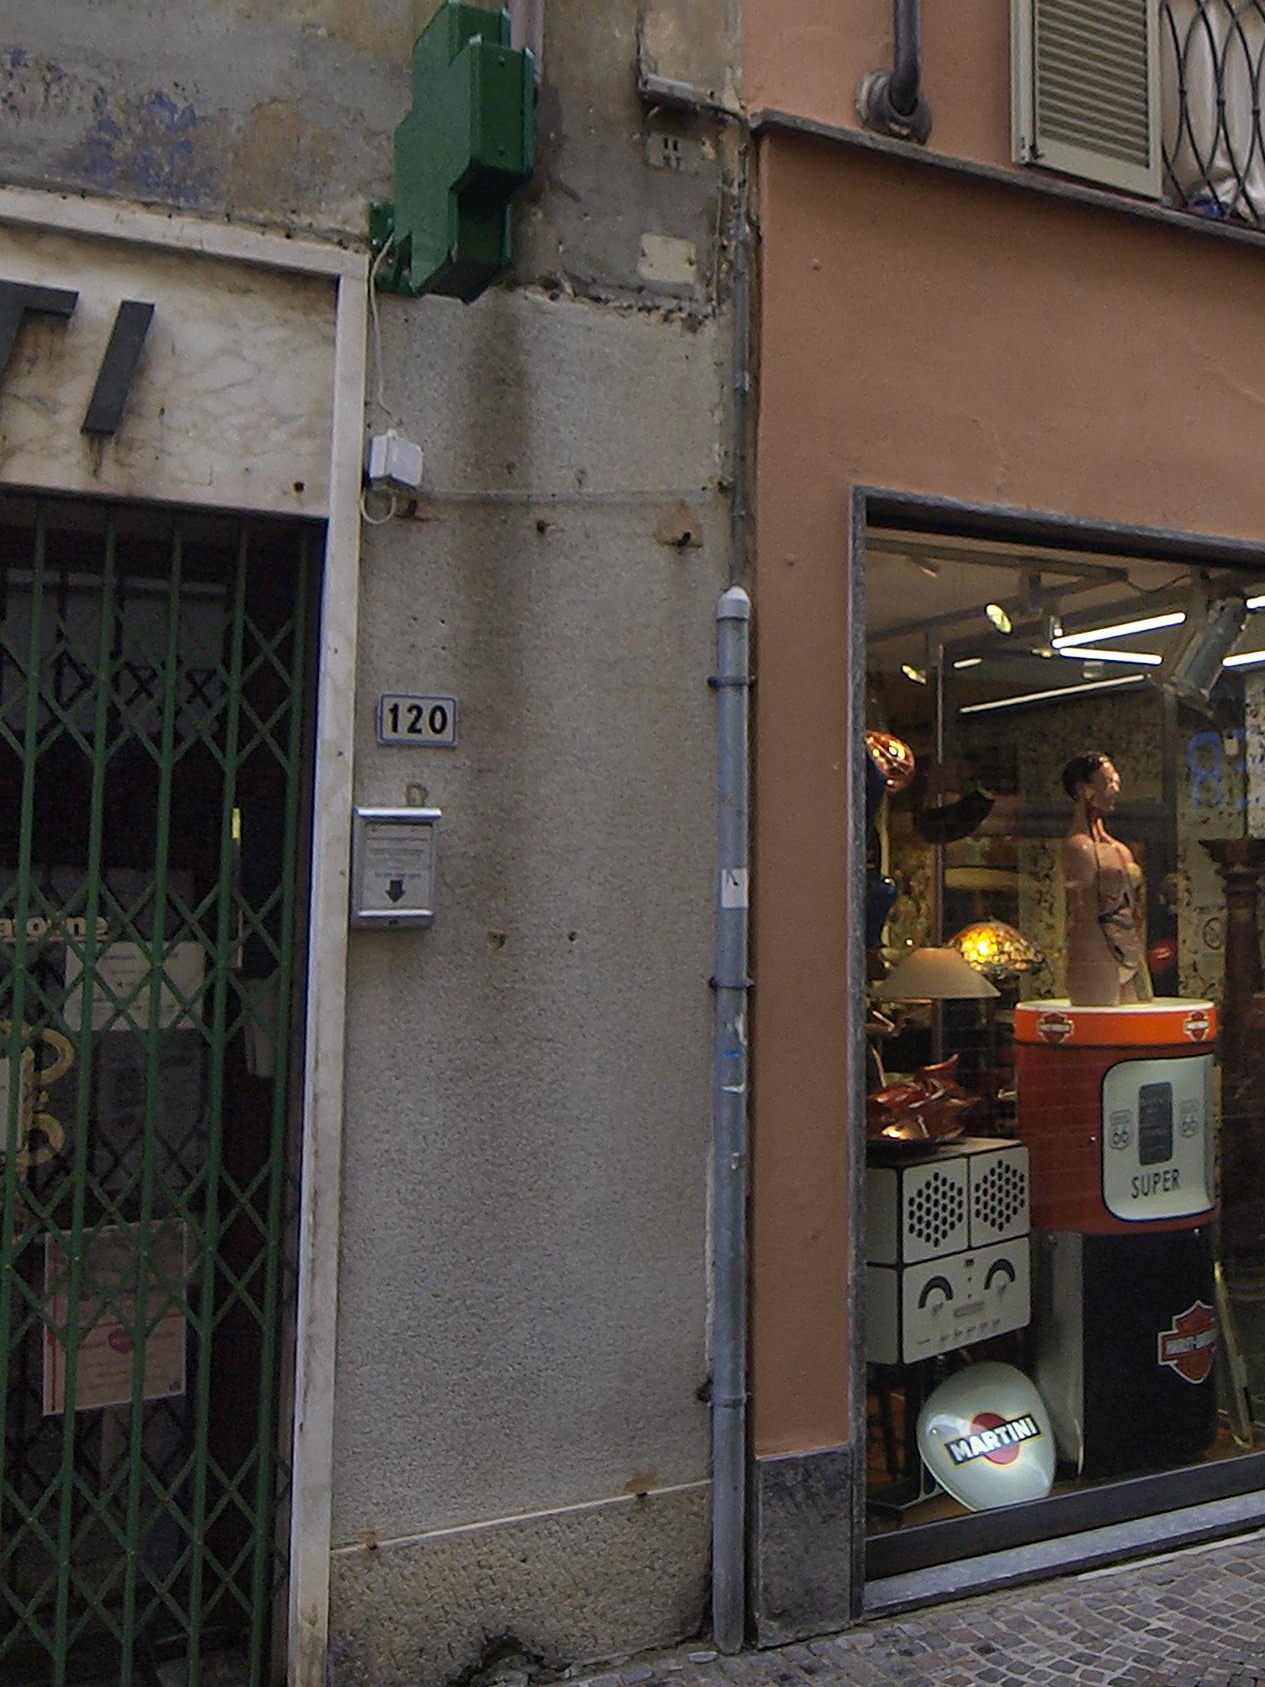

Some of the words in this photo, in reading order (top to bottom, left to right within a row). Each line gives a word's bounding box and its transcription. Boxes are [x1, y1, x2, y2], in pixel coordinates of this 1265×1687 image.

[389, 703, 448, 735] 120
[1131, 1168, 1181, 1199] SUPER
[949, 1417, 1038, 1462] MARTINI
